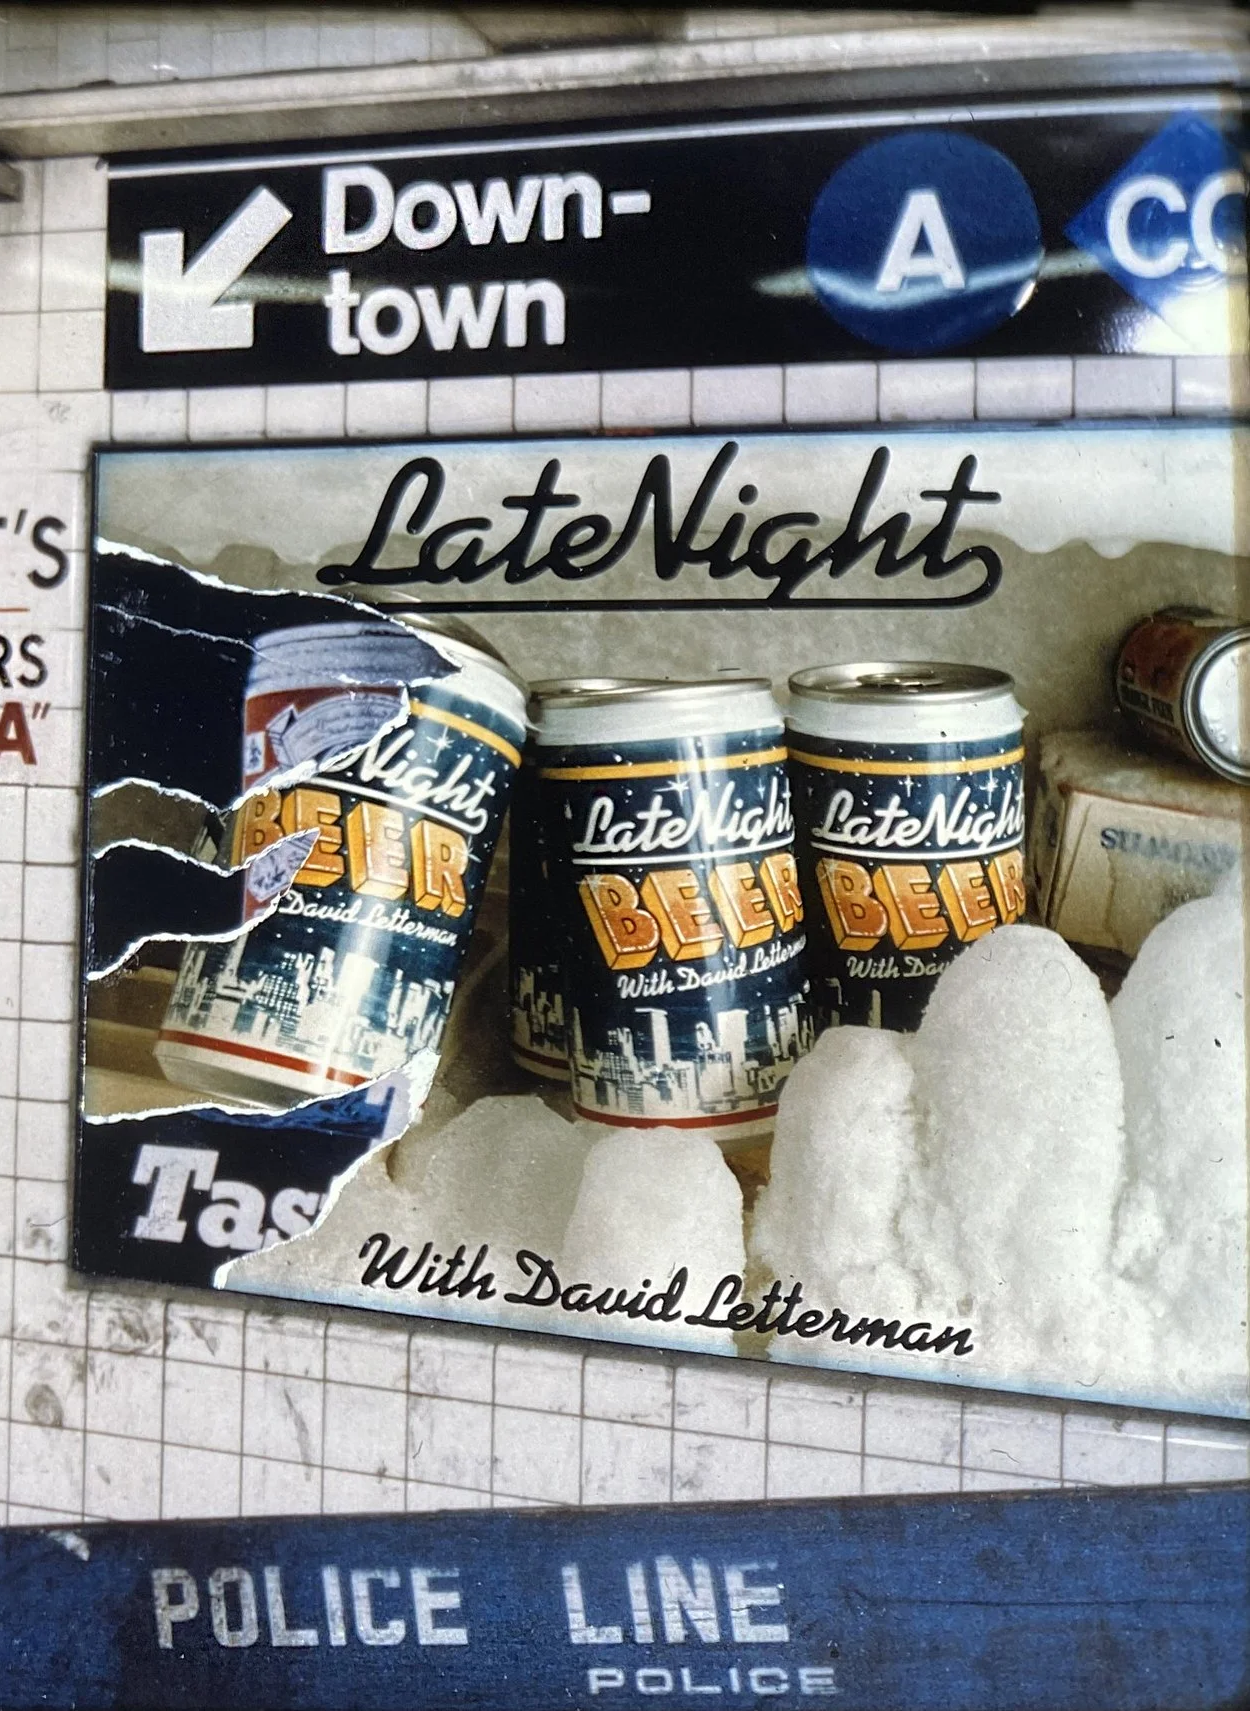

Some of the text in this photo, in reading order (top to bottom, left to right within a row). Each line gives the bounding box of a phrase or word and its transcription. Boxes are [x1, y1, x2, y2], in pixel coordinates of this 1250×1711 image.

[323, 163, 651, 255] Down-
[876, 188, 966, 292] A
[1106, 168, 1248, 280] CC
[324, 267, 566, 356] town
[231, 787, 468, 919] BEER
[815, 849, 1027, 952] BEER
[578, 853, 805, 971] BEER
[617, 969, 675, 999] With
[677, 958, 748, 992] David
[846, 955, 900, 979] With
[132, 1143, 331, 1252] Tas
[359, 1232, 975, 1357] With David Letterman
[151, 1555, 791, 1650] POLICE LINE
[586, 1666, 842, 1696] POLICE
